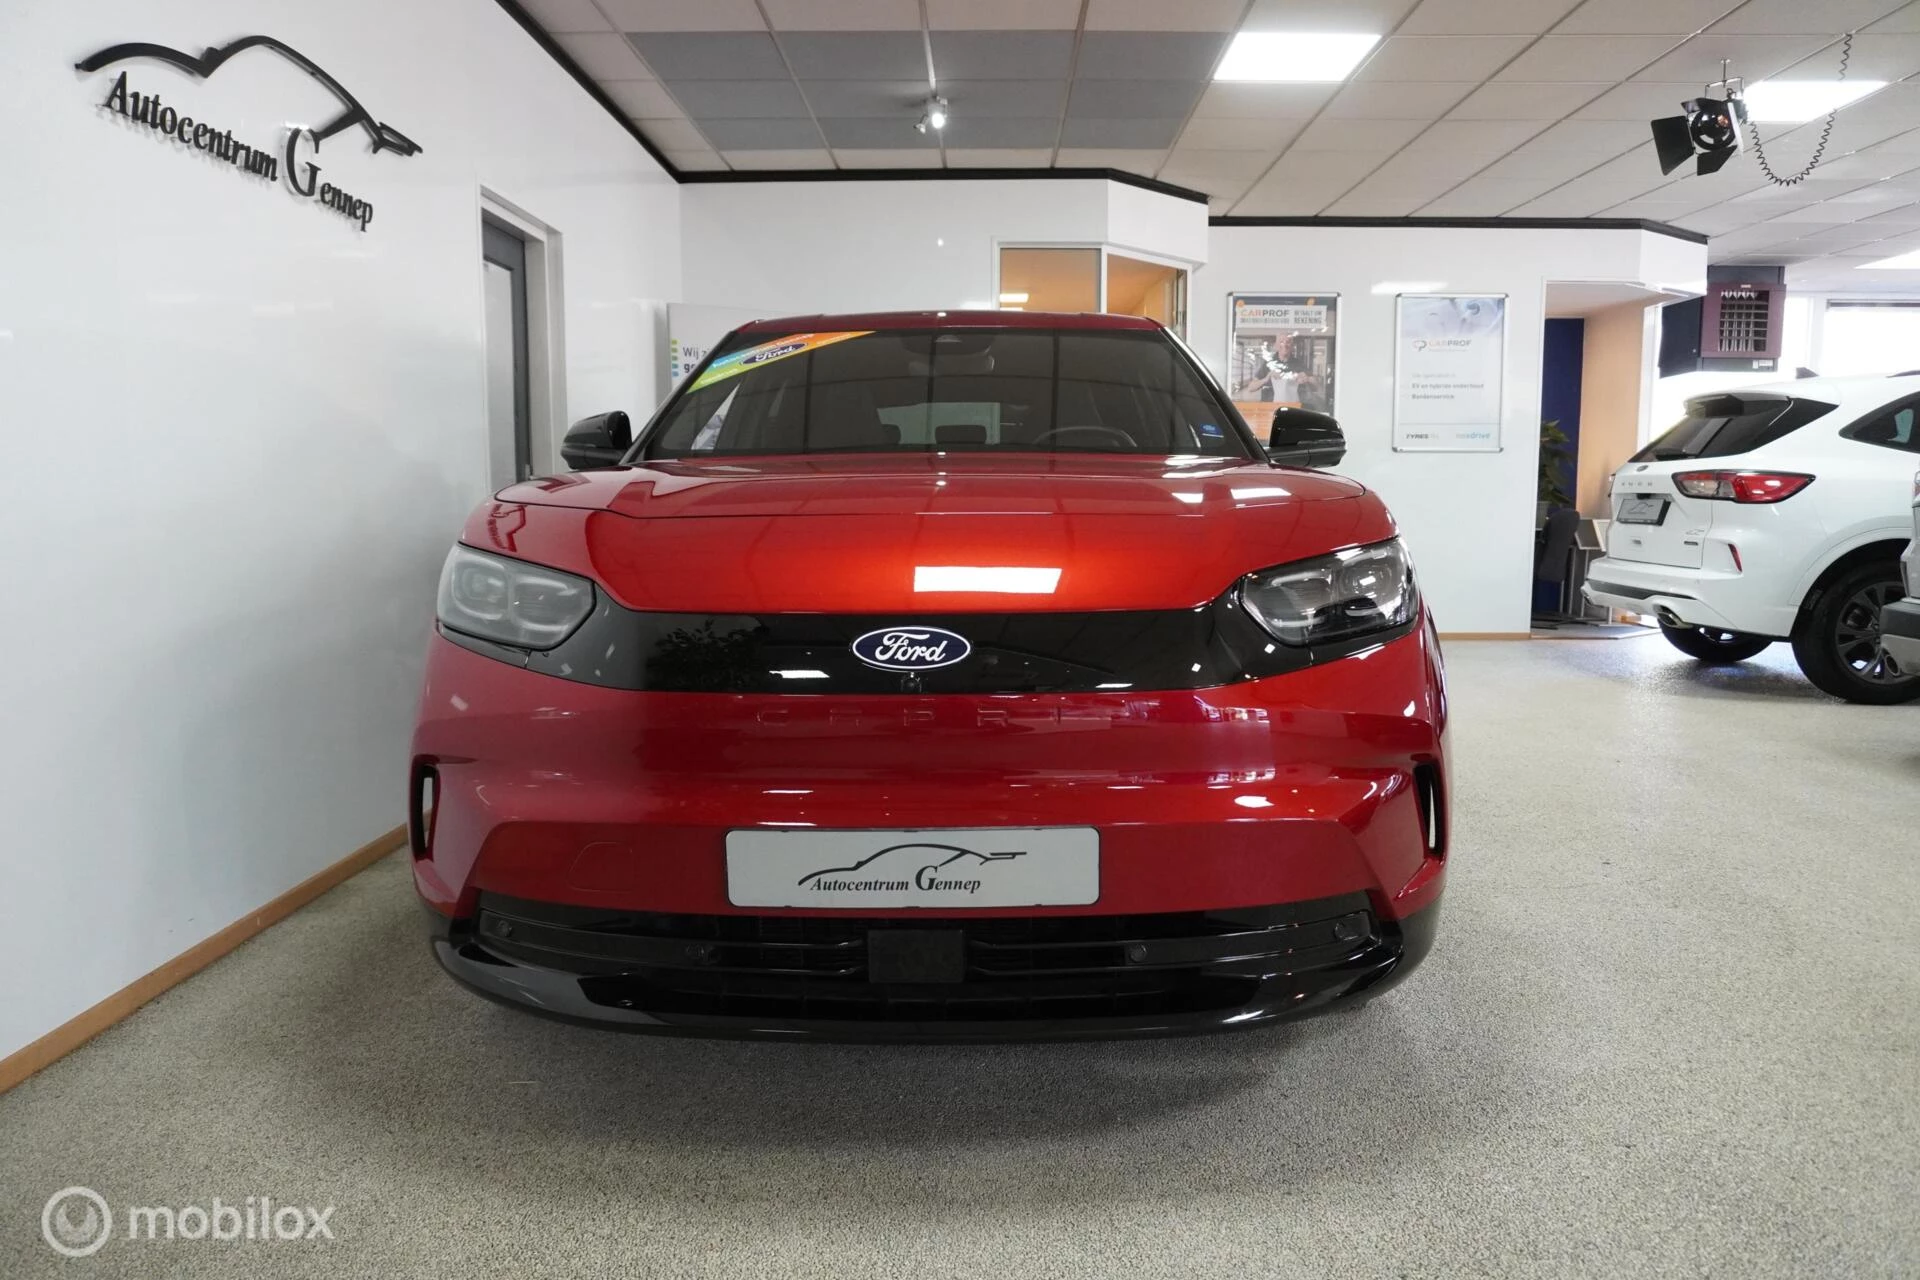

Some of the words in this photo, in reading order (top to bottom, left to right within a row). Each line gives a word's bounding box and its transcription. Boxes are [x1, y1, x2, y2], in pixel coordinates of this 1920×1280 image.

[102, 70, 278, 182] Autocentrum
[286, 127, 374, 232] Gennep
[1240, 308, 1290, 318] CARPROF
[682, 345, 699, 360] Wij
[755, 346, 795, 362] Ford
[875, 631, 948, 662] Ford
[757, 707, 1061, 727] CAPRI
[810, 877, 909, 892] Autocentrum
[915, 865, 981, 894] Gennep
